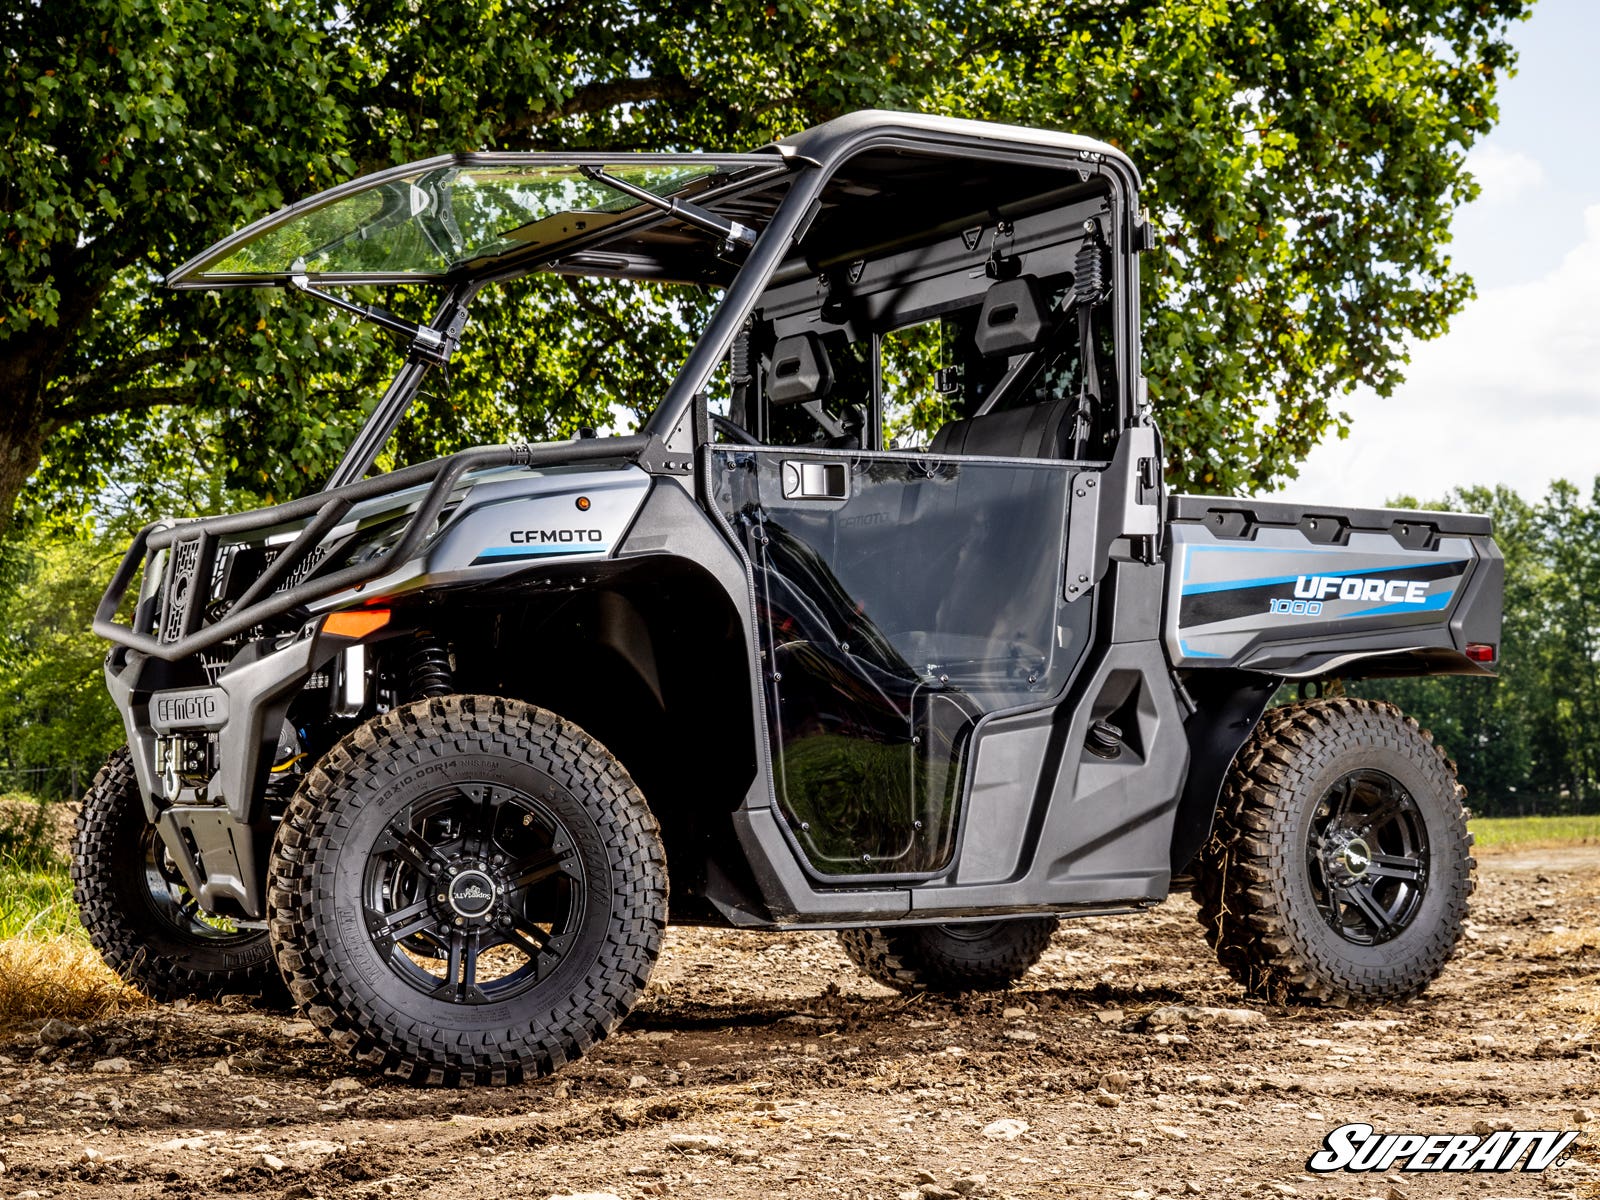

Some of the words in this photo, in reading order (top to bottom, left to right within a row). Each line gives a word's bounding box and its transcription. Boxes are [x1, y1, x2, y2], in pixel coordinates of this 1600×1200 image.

[510, 529, 602, 543] CFMOTO
[1294, 575, 1430, 603] UFORCE
[1269, 598, 1323, 616] 1000
[158, 695, 215, 721] CFMOTO
